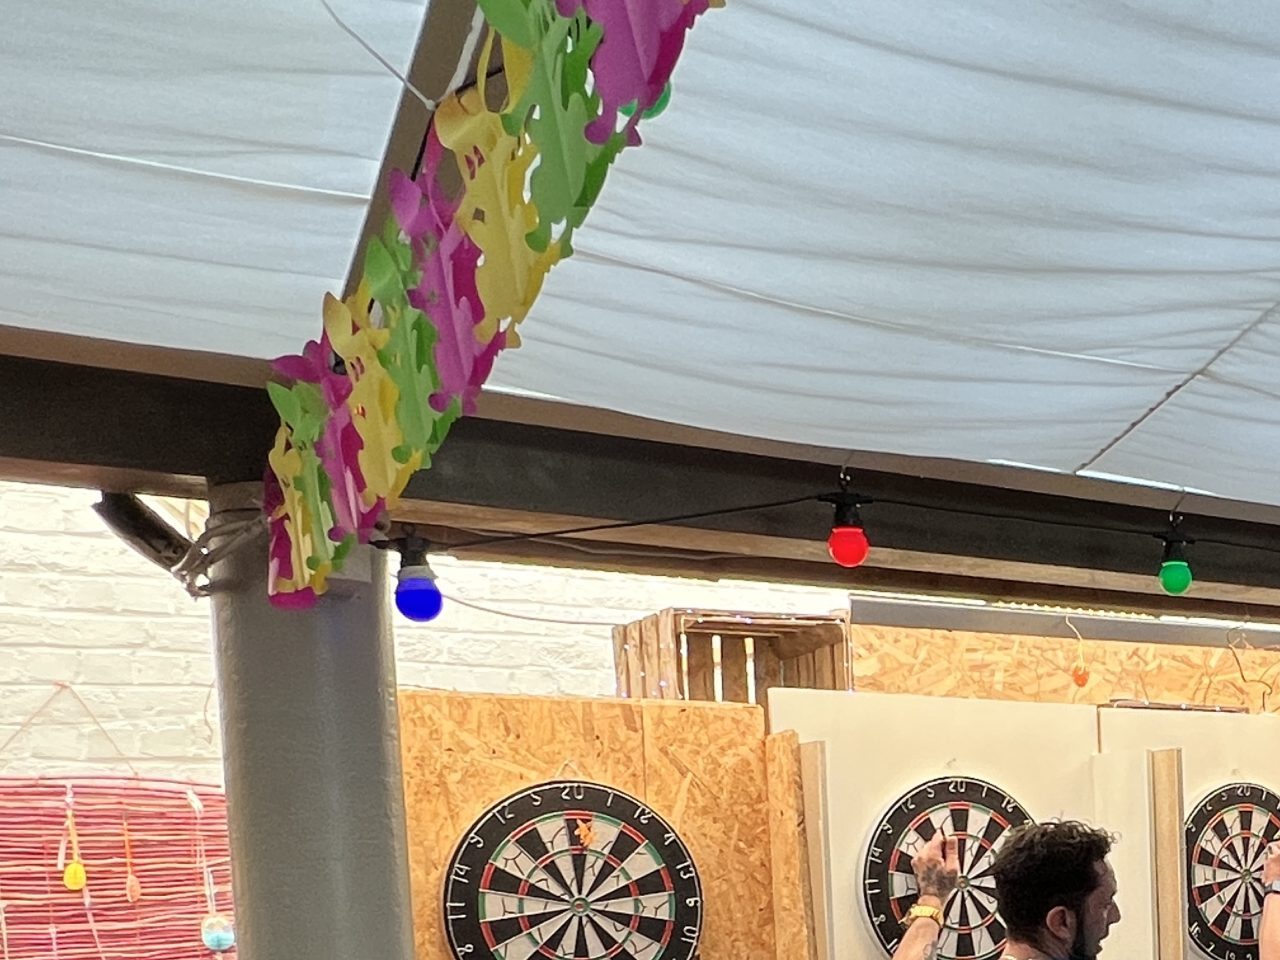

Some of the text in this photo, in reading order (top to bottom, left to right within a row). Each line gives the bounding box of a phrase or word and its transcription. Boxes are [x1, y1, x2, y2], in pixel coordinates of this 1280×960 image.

[560, 784, 585, 800] 20
[948, 781, 966, 793] 20
[530, 792, 542, 806] 5
